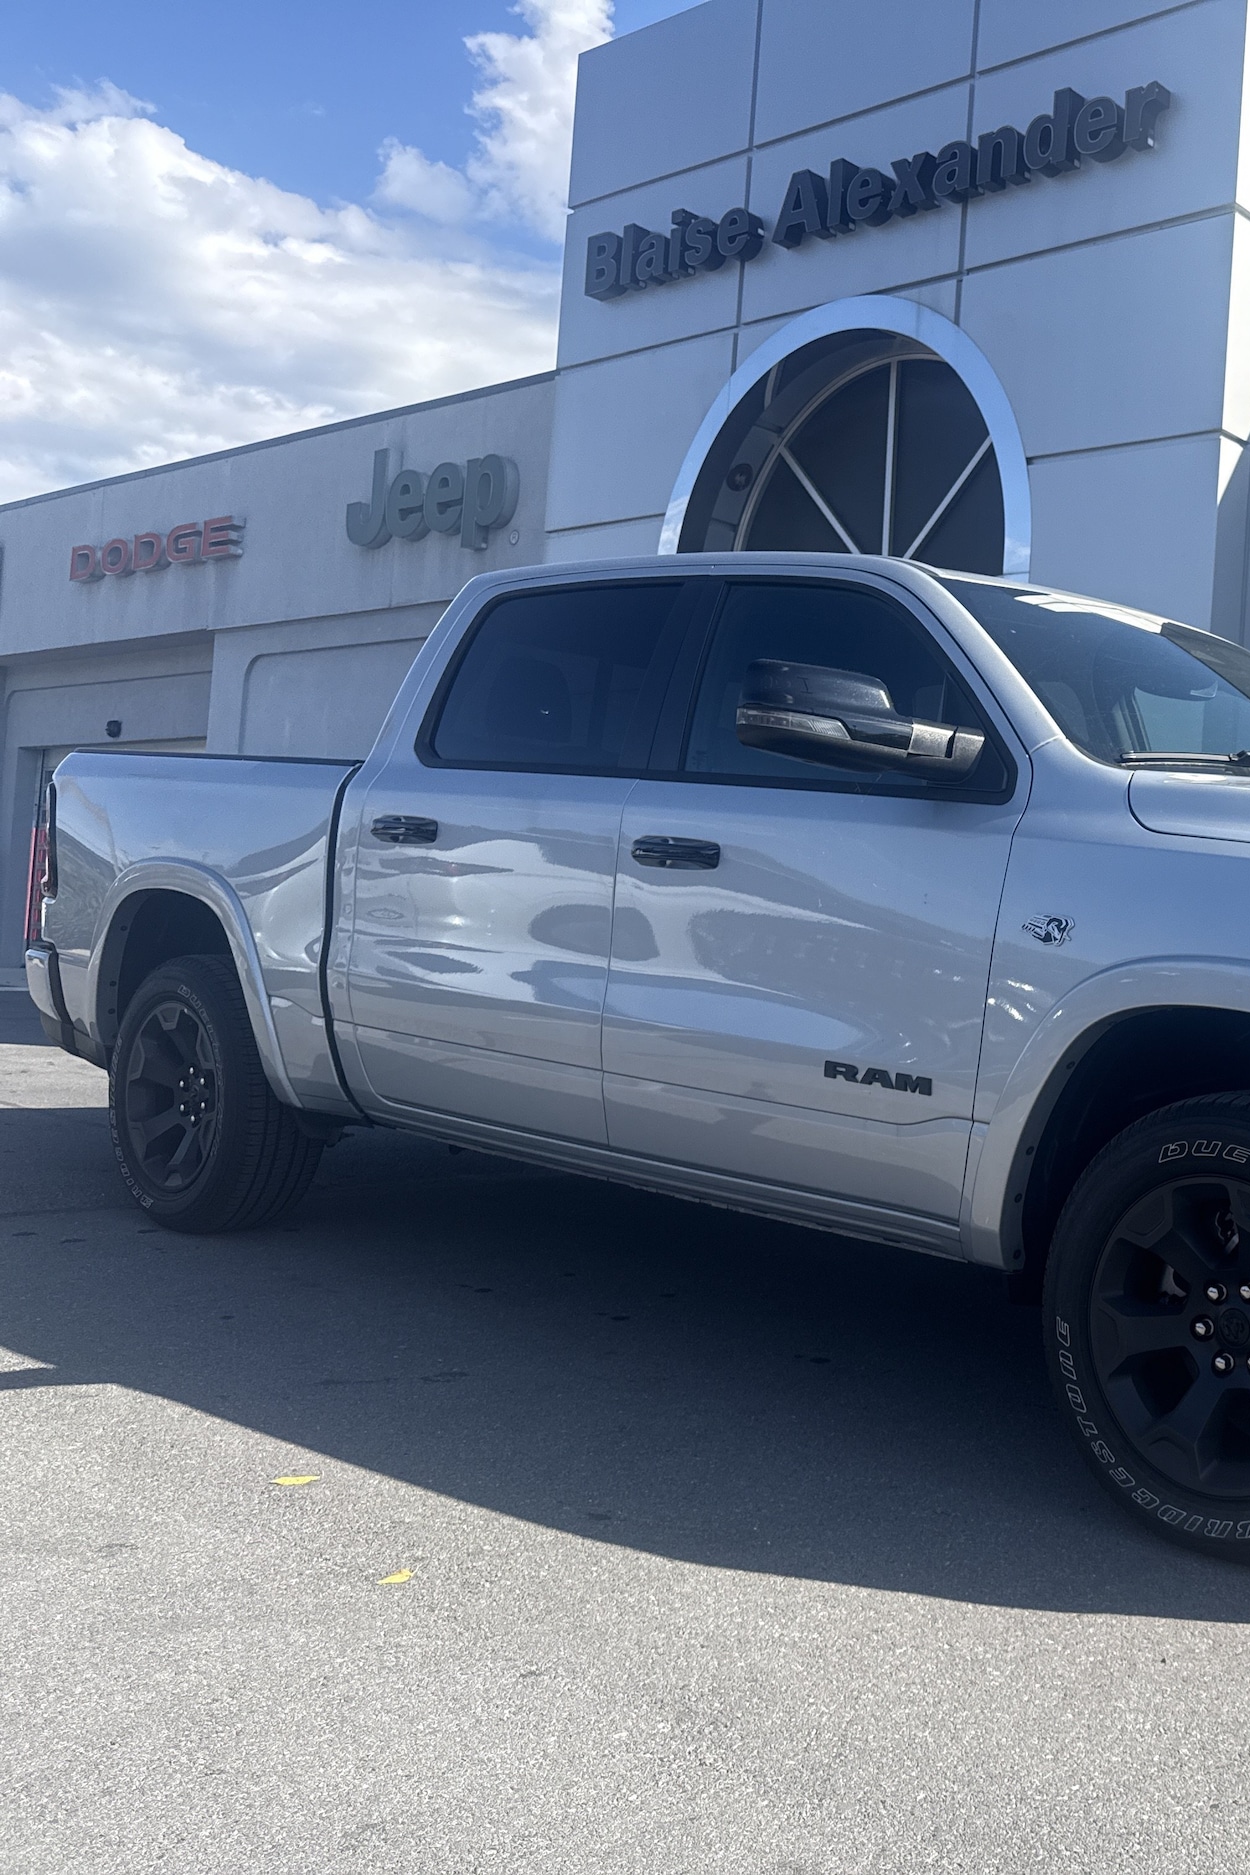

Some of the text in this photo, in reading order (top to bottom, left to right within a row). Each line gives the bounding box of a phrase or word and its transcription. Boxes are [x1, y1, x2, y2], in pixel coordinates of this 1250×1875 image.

[584, 80, 1171, 300] Blaise Alexander
[346, 446, 519, 551] Jeep
[69, 515, 245, 582] DODGE
[823, 1060, 933, 1096] RAM
